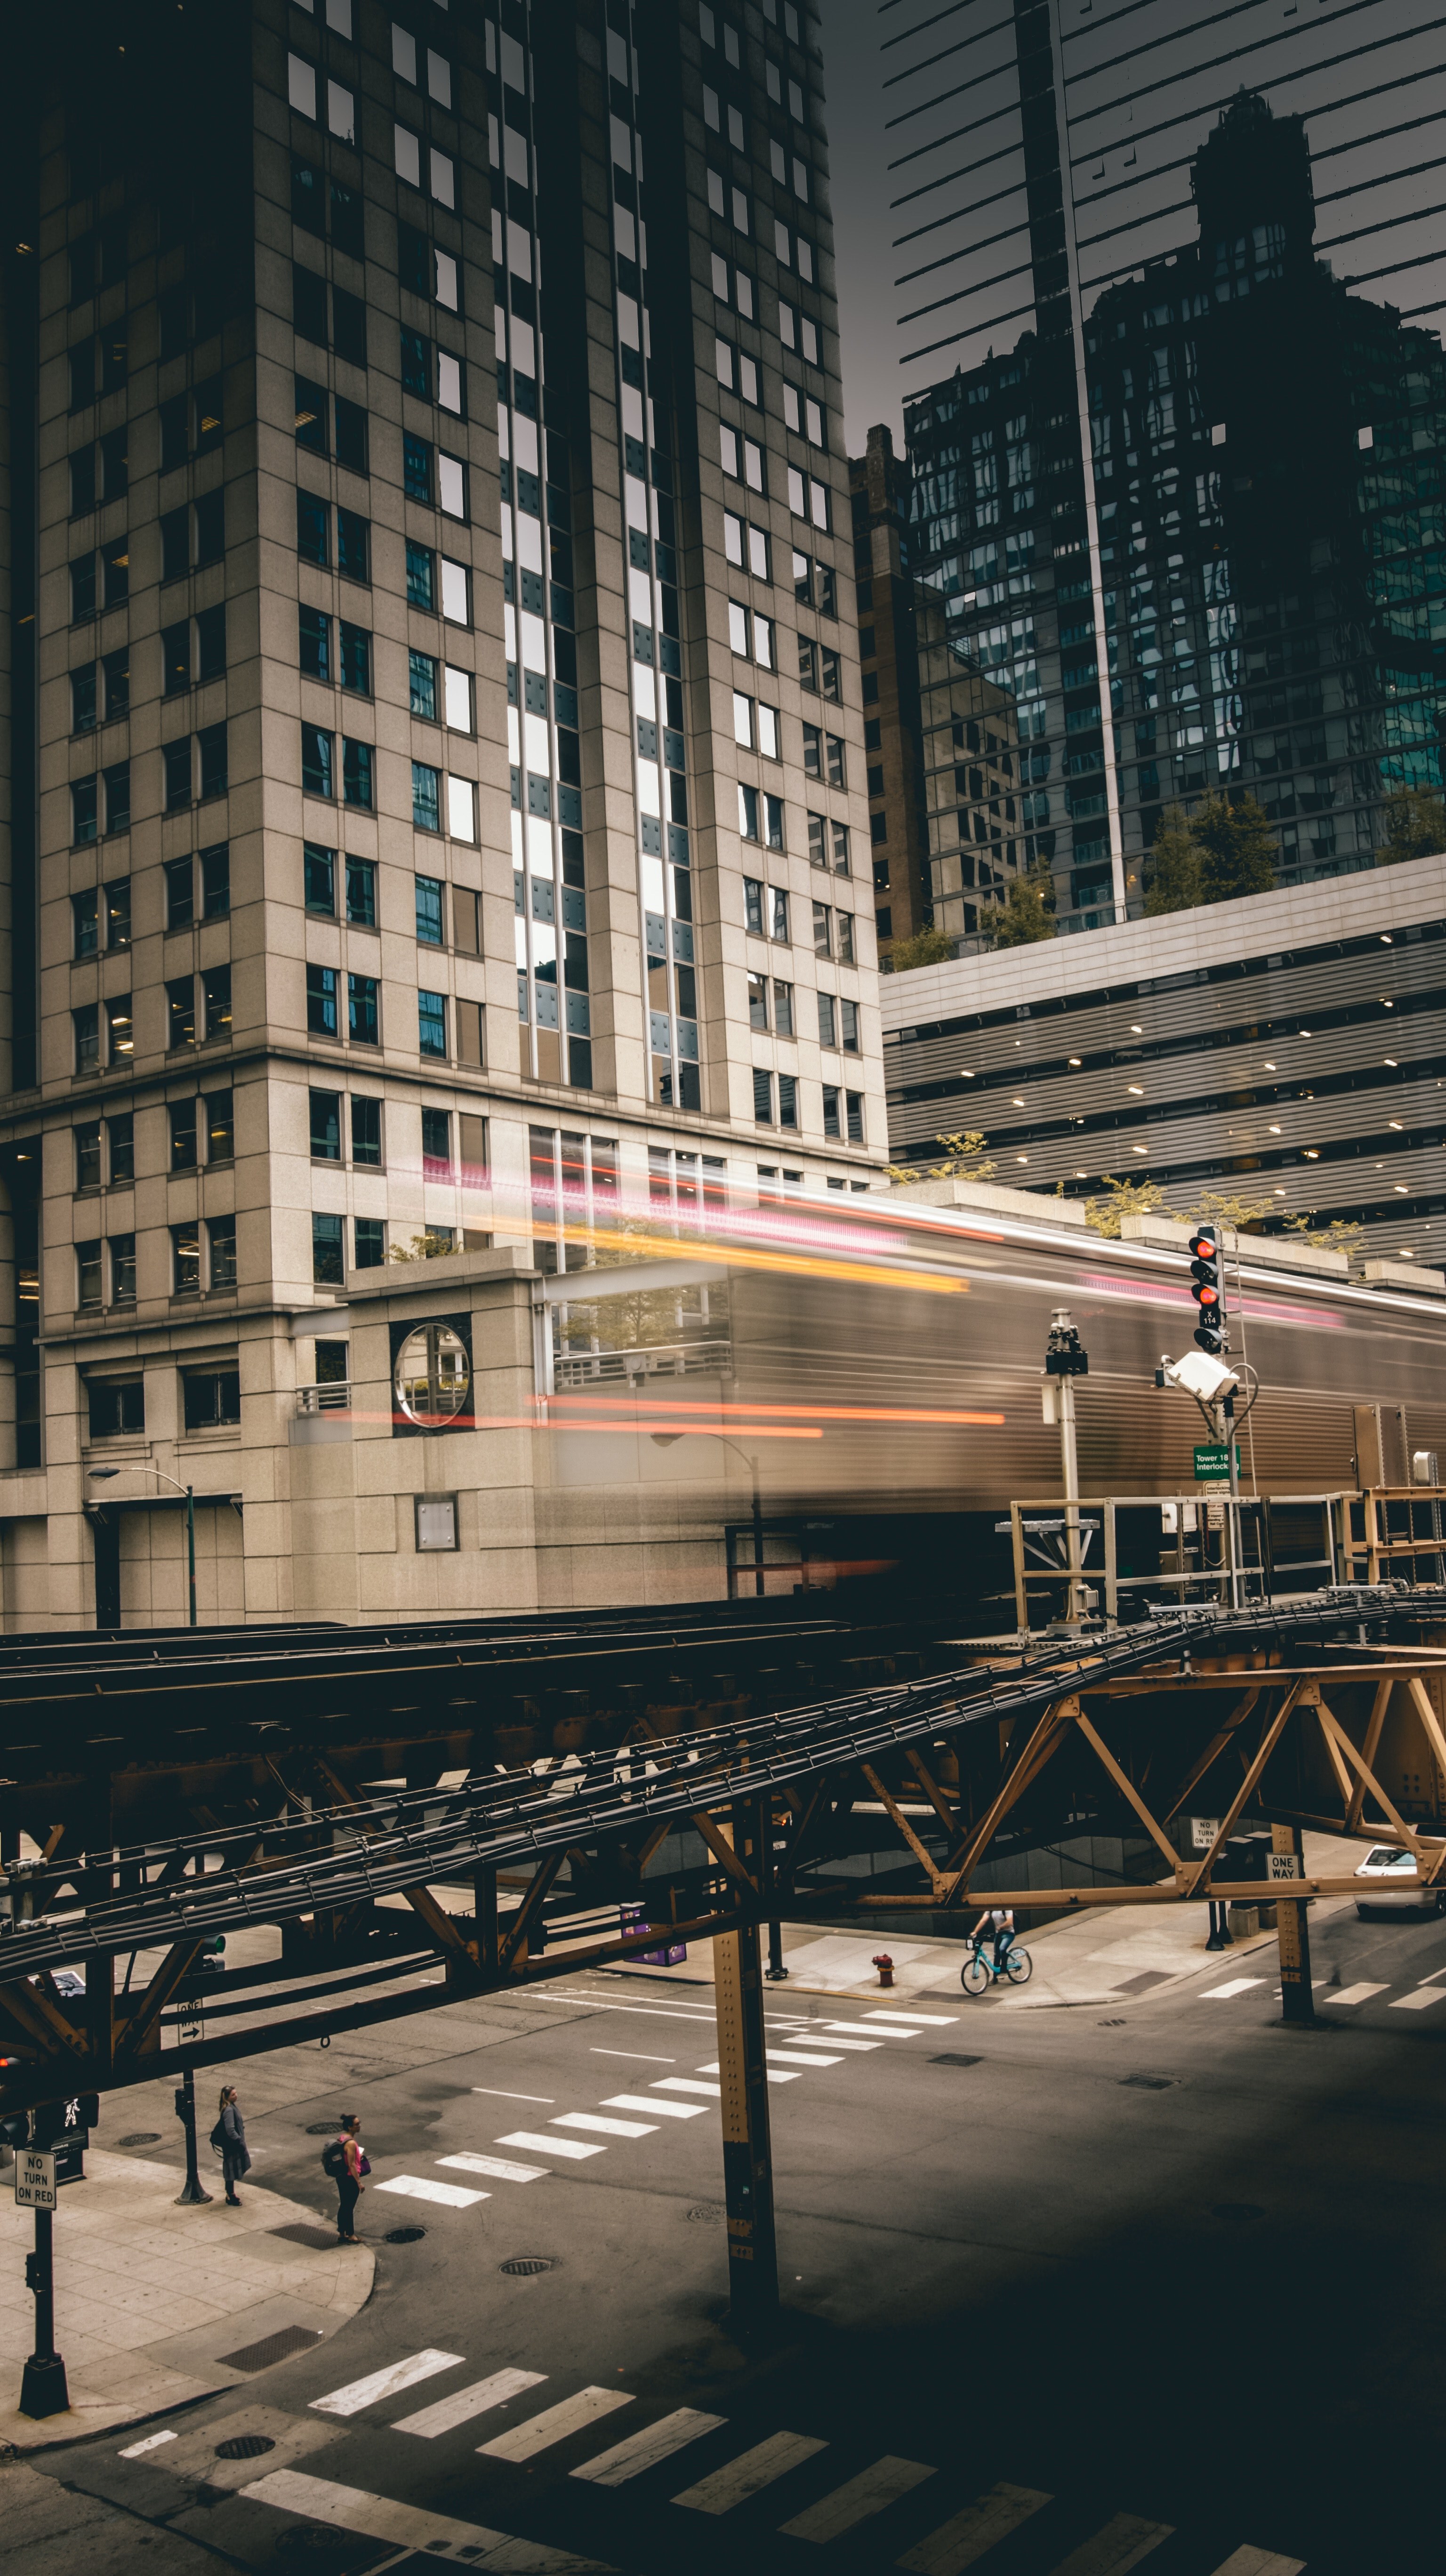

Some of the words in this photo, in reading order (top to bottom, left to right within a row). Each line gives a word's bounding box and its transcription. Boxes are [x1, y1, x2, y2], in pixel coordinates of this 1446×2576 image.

[1197, 1463, 1239, 1471] Interlockg
[1272, 1857, 1293, 1868] ONE
[1272, 1868, 1294, 1879] WAY
[28, 2157, 42, 2169] NO
[24, 2172, 48, 2186] TURN
[19, 2187, 31, 2199] ON
[35, 2190, 53, 2202] RED
